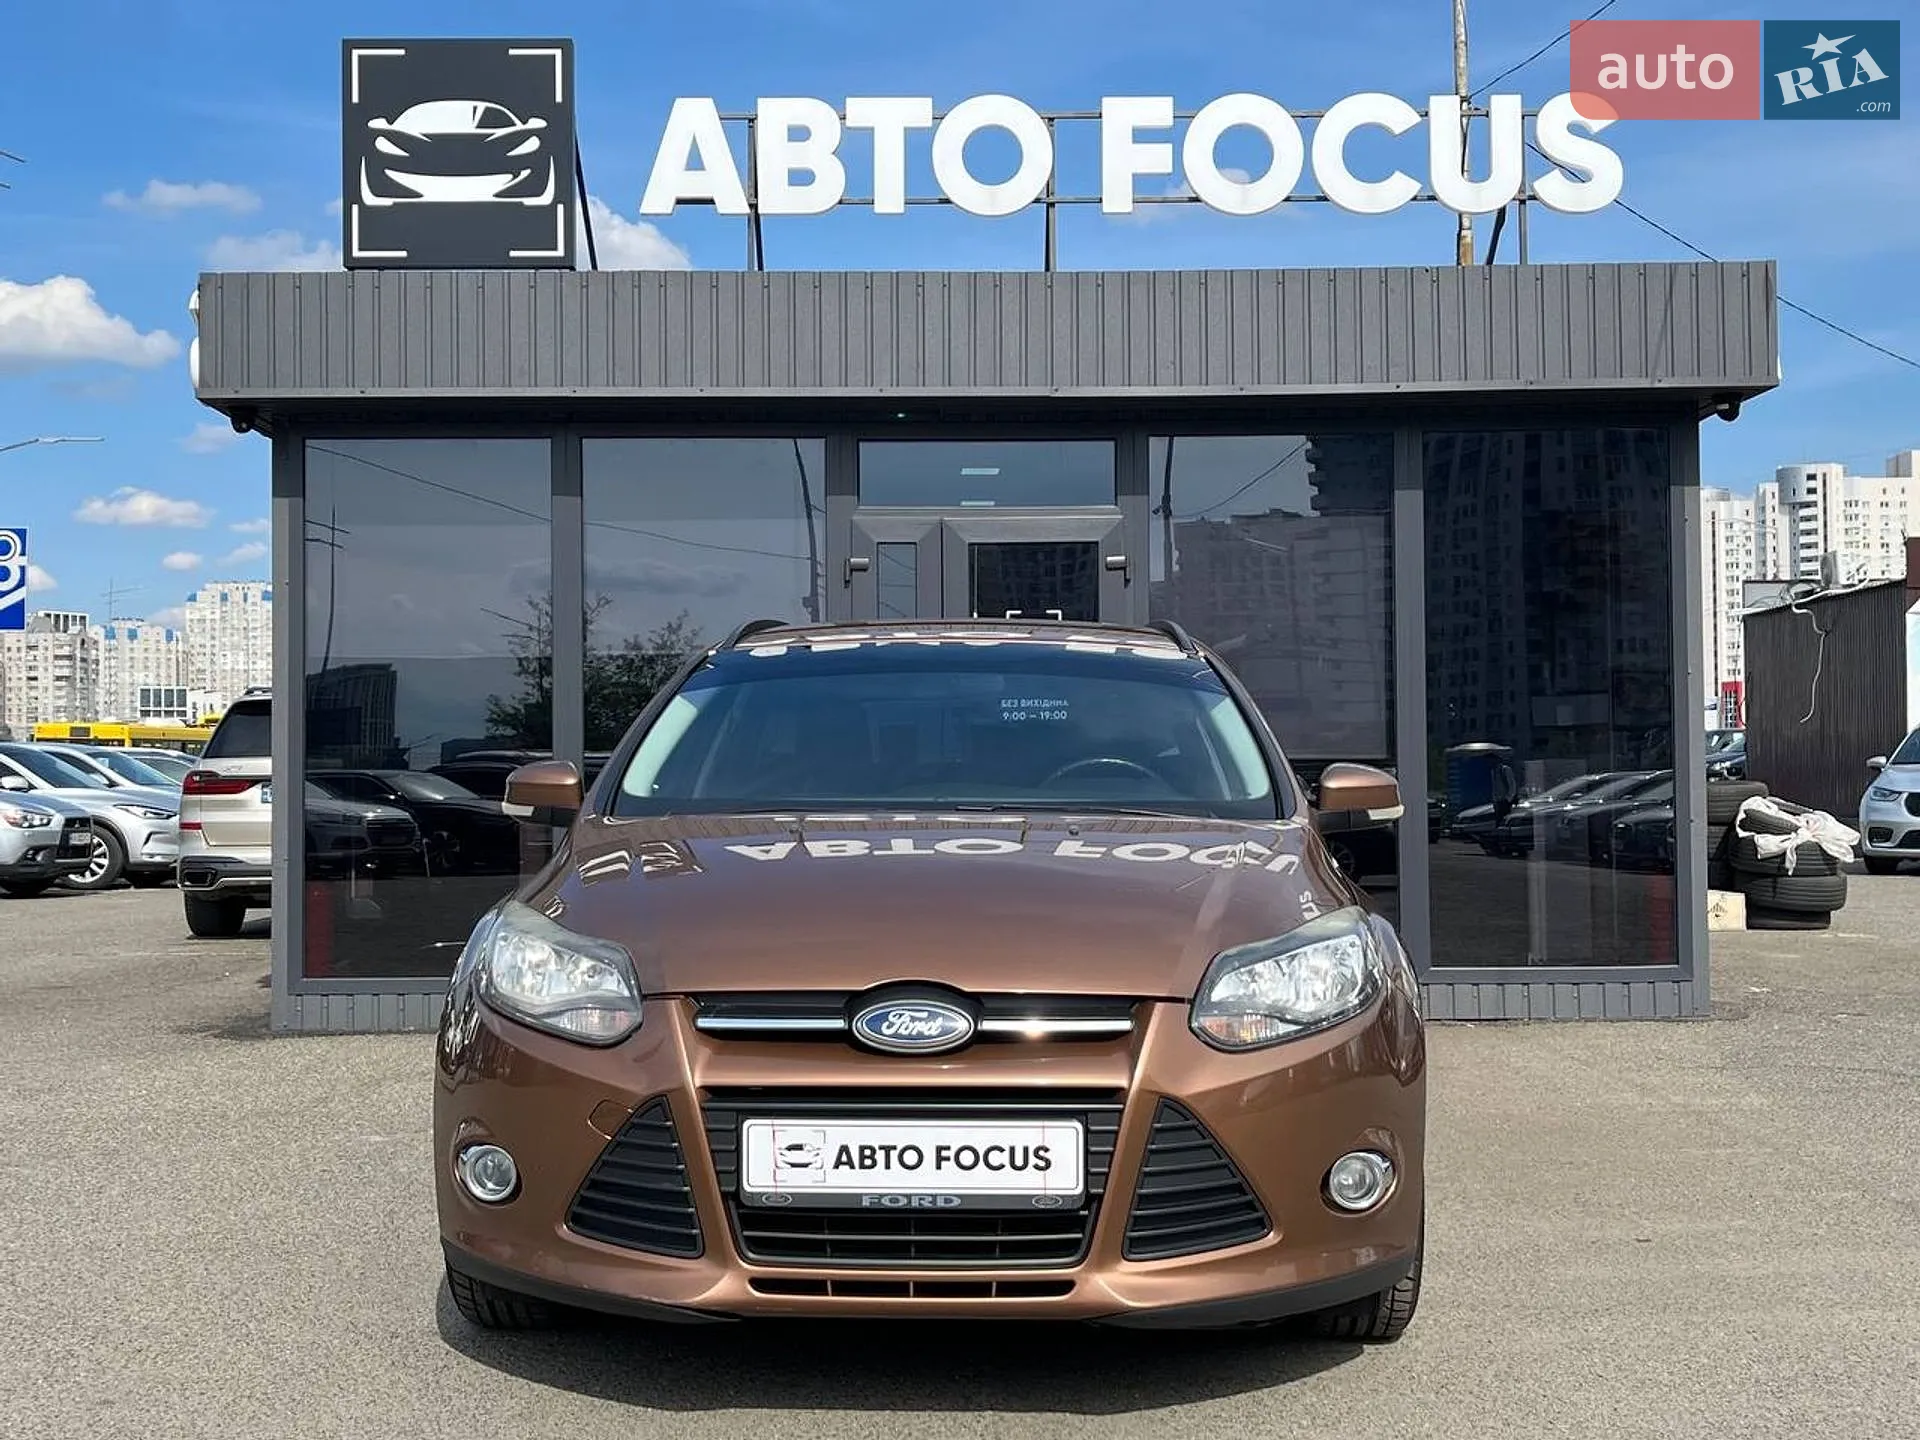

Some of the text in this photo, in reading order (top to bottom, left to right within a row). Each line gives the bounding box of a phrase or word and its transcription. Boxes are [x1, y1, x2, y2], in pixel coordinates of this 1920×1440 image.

[639, 92, 1625, 216] АВТО FOCUS
[881, 1009, 943, 1036] Ford
[832, 1144, 1052, 1172] АВТО FOCUS
[861, 1194, 962, 1208] FORD
